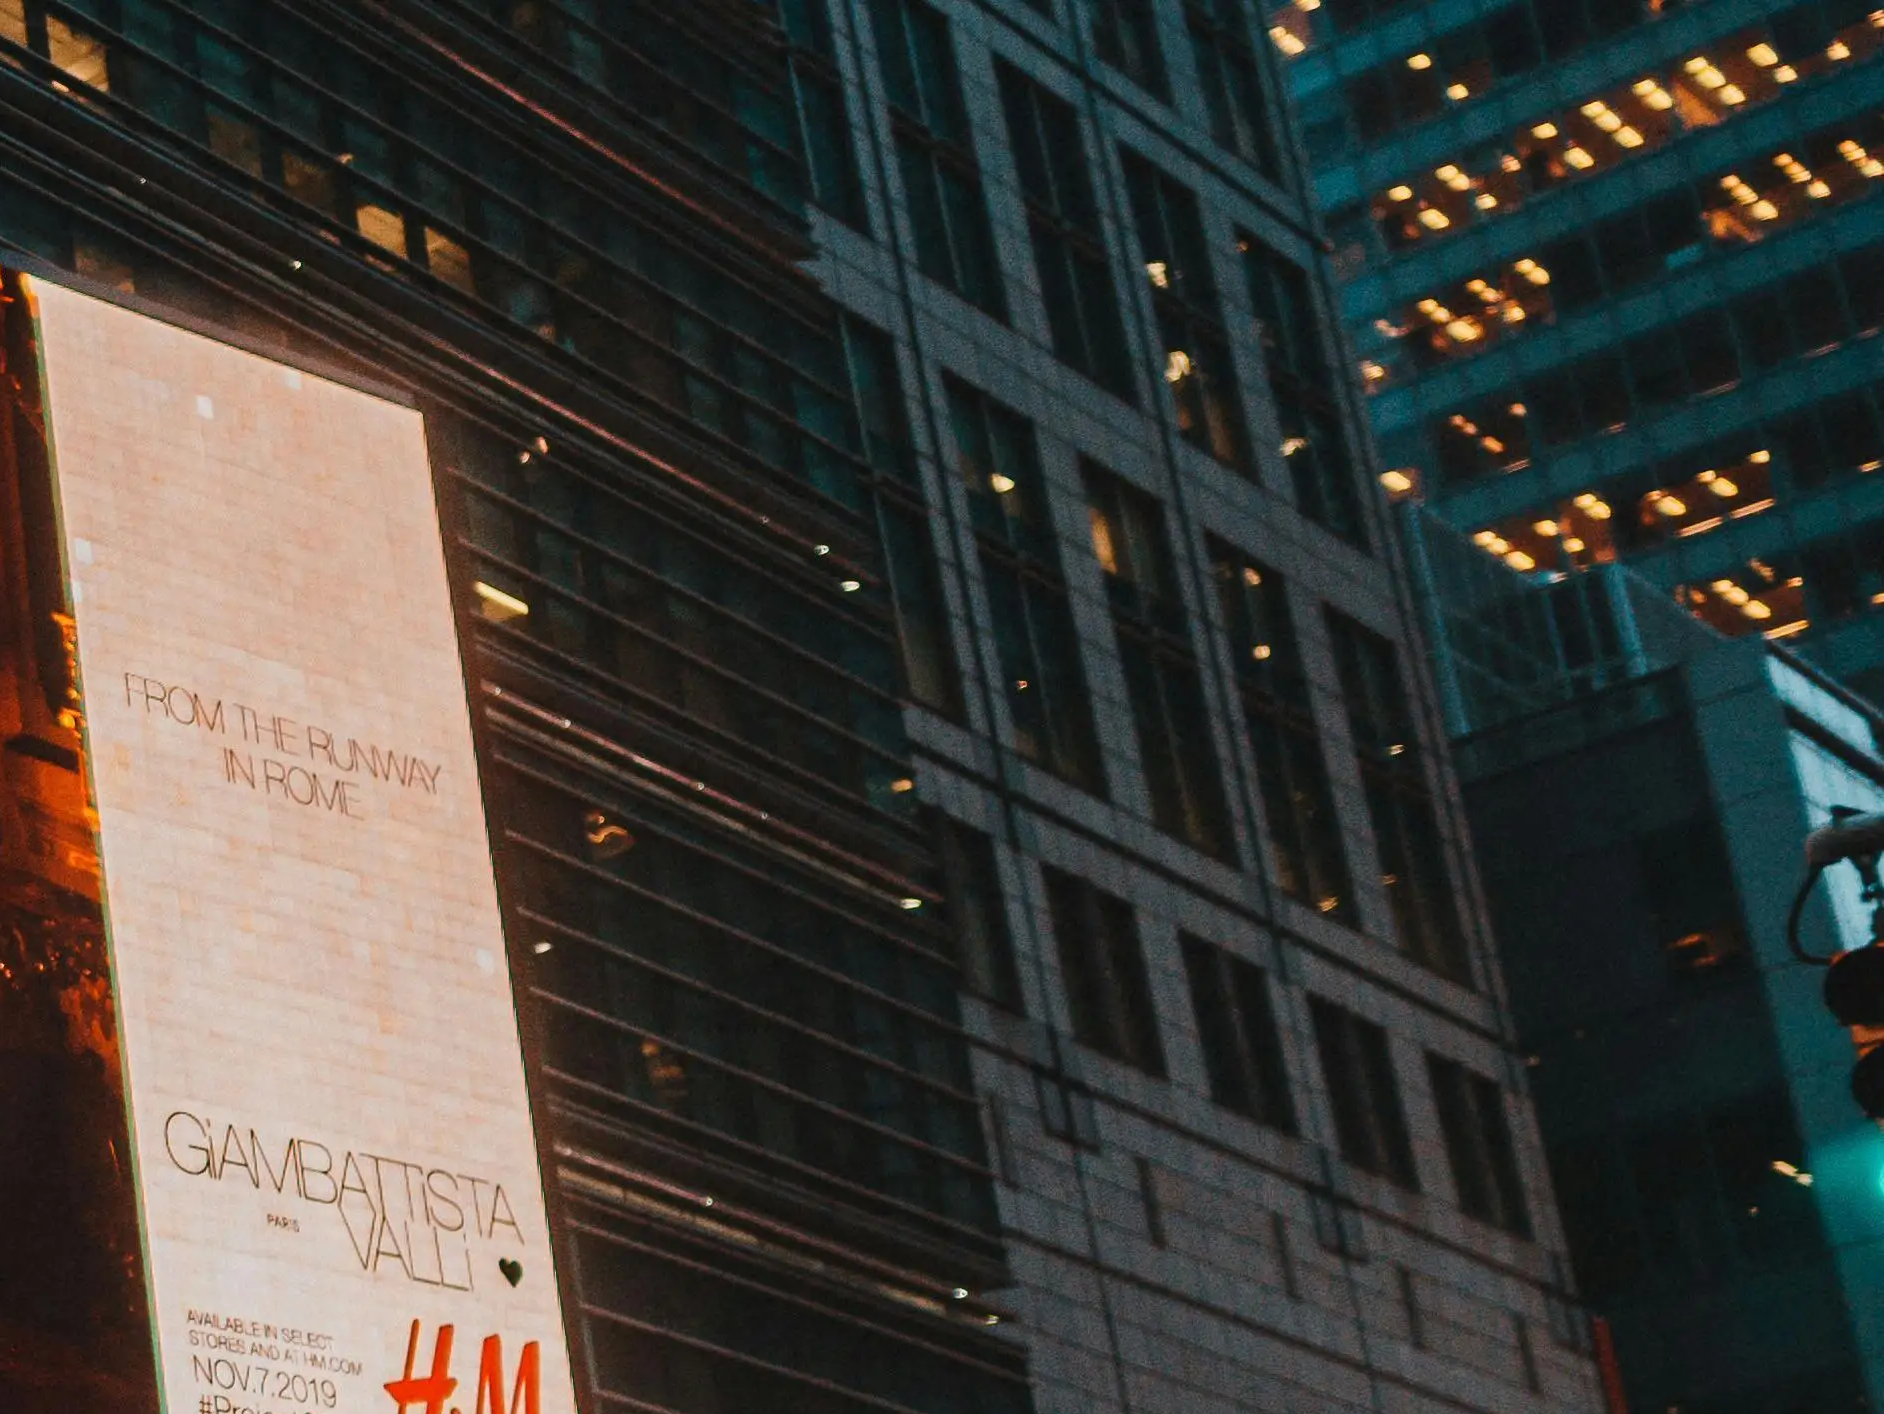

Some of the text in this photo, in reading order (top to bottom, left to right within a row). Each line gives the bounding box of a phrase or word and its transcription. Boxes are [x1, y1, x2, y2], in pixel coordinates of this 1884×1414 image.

[124, 671, 442, 796] FROM THE RUNWAY
[222, 747, 366, 822] IN ROME
[186, 1308, 335, 1350] AVAILABLE IN SELECT
[188, 1328, 364, 1377] STORES AND AT HM.COM
[192, 1353, 338, 1410] NOV.7.2019
